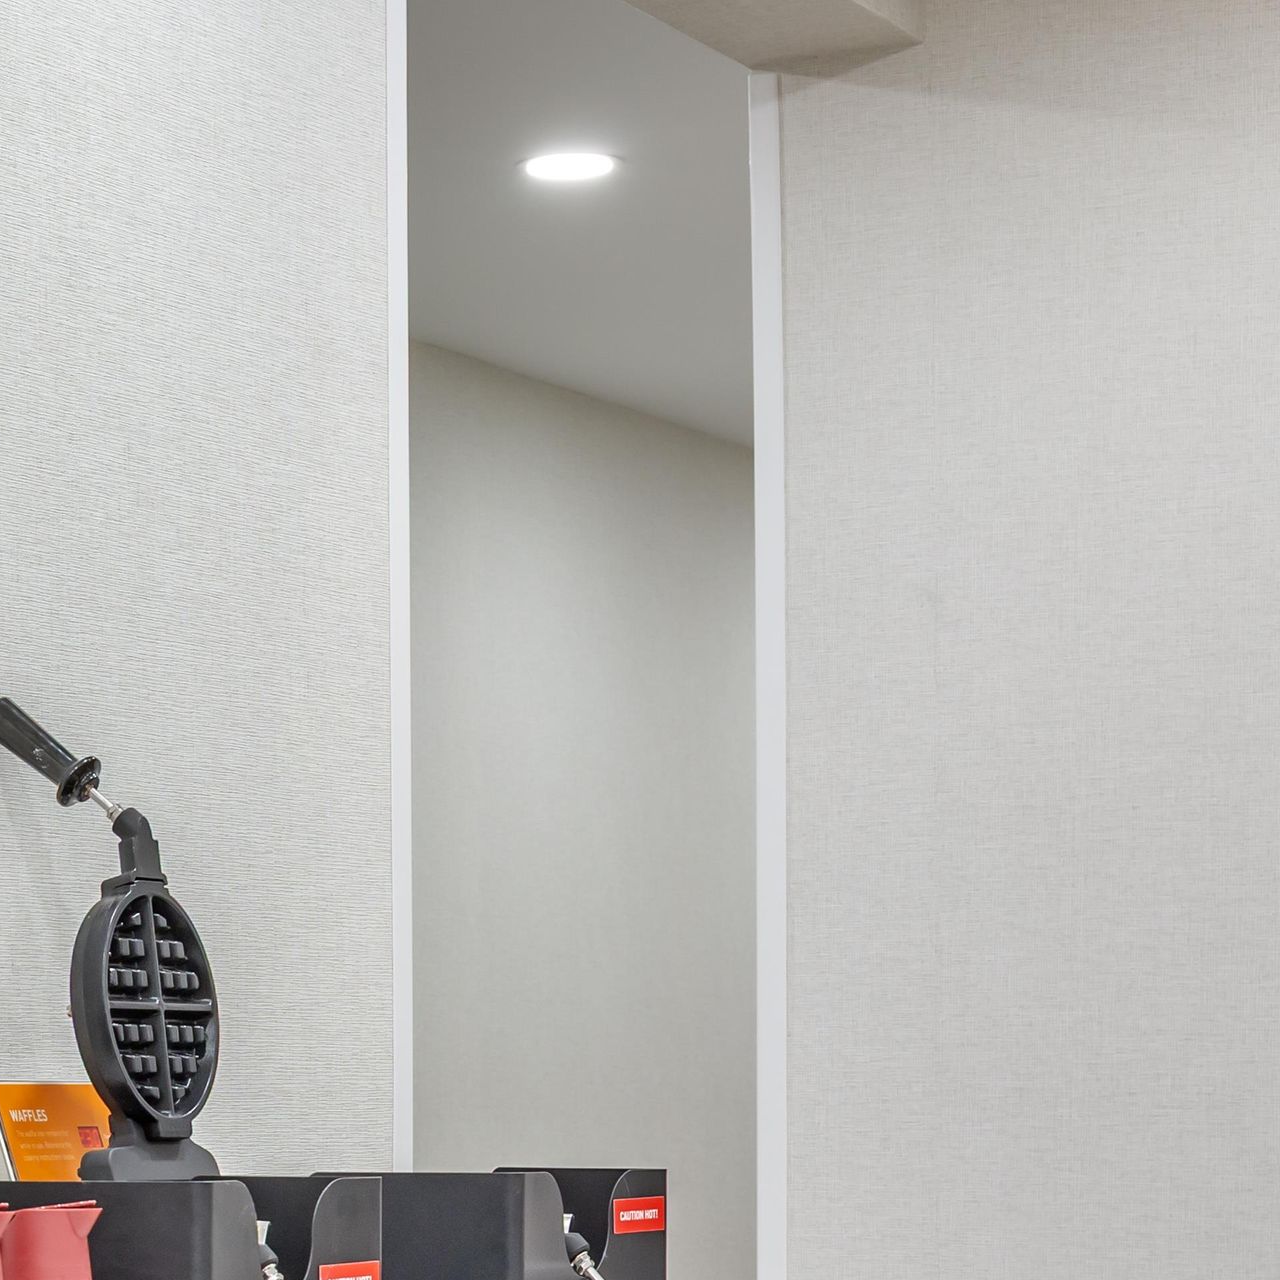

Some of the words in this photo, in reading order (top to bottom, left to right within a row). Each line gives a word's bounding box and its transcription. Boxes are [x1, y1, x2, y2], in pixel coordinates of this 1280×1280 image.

[9, 1109, 48, 1122] WAFFLES
[619, 1210, 644, 1221] CAUTION
[644, 1208, 659, 1220] HOT!
